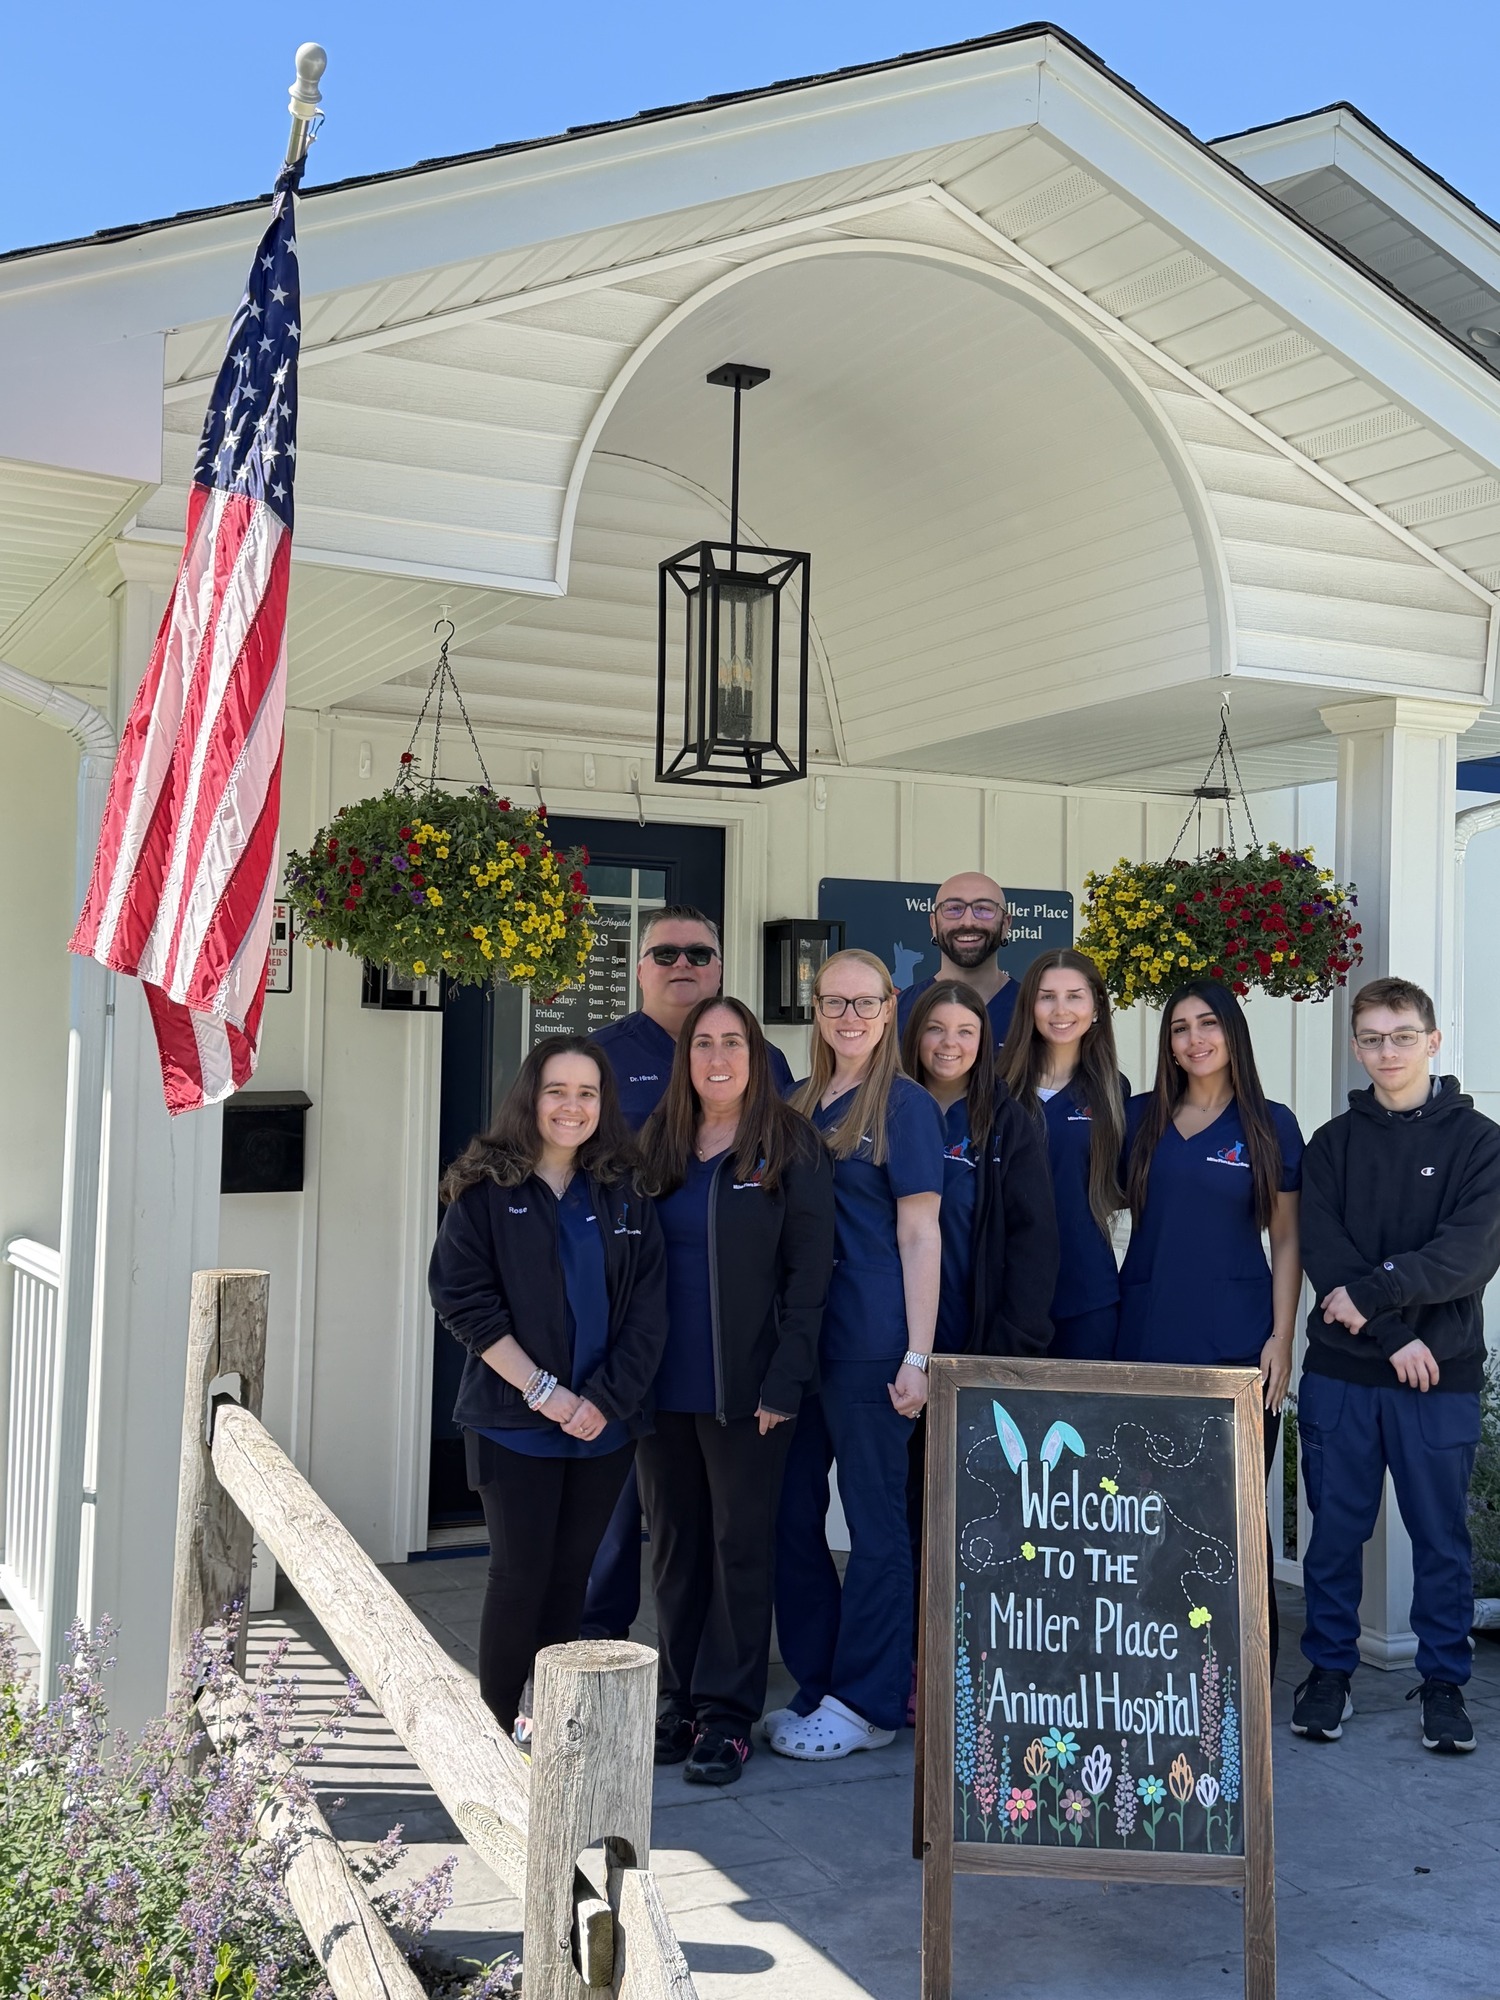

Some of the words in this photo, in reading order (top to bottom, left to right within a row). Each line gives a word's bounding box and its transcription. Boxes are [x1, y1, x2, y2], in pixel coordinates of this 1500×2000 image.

[905, 897, 936, 912] Welc
[1007, 902, 1030, 917] ller
[1033, 904, 1069, 919] Place
[1007, 925, 1042, 942] spital
[589, 954, 605, 963] 9am
[611, 955, 627, 964] 5pm
[588, 969, 604, 978] 9am
[611, 970, 627, 979] 5pm
[588, 983, 604, 992] 9am
[610, 984, 626, 993] 6pm
[588, 997, 604, 1006] 9am
[611, 998, 626, 1007] 7pm
[535, 1008, 565, 1020] Friday:
[588, 1011, 603, 1020] 9am
[534, 1023, 575, 1035] Saturday:
[508, 1206, 528, 1214] Rose
[1020, 1461, 1162, 1535] Welcome
[1037, 1546, 1075, 1580] TO
[1083, 1547, 1139, 1584] THE
[990, 1592, 1080, 1653] Miller
[1095, 1597, 1179, 1660] Place
[985, 1667, 1089, 1729] Animal
[1095, 1671, 1200, 1766] Hospital
